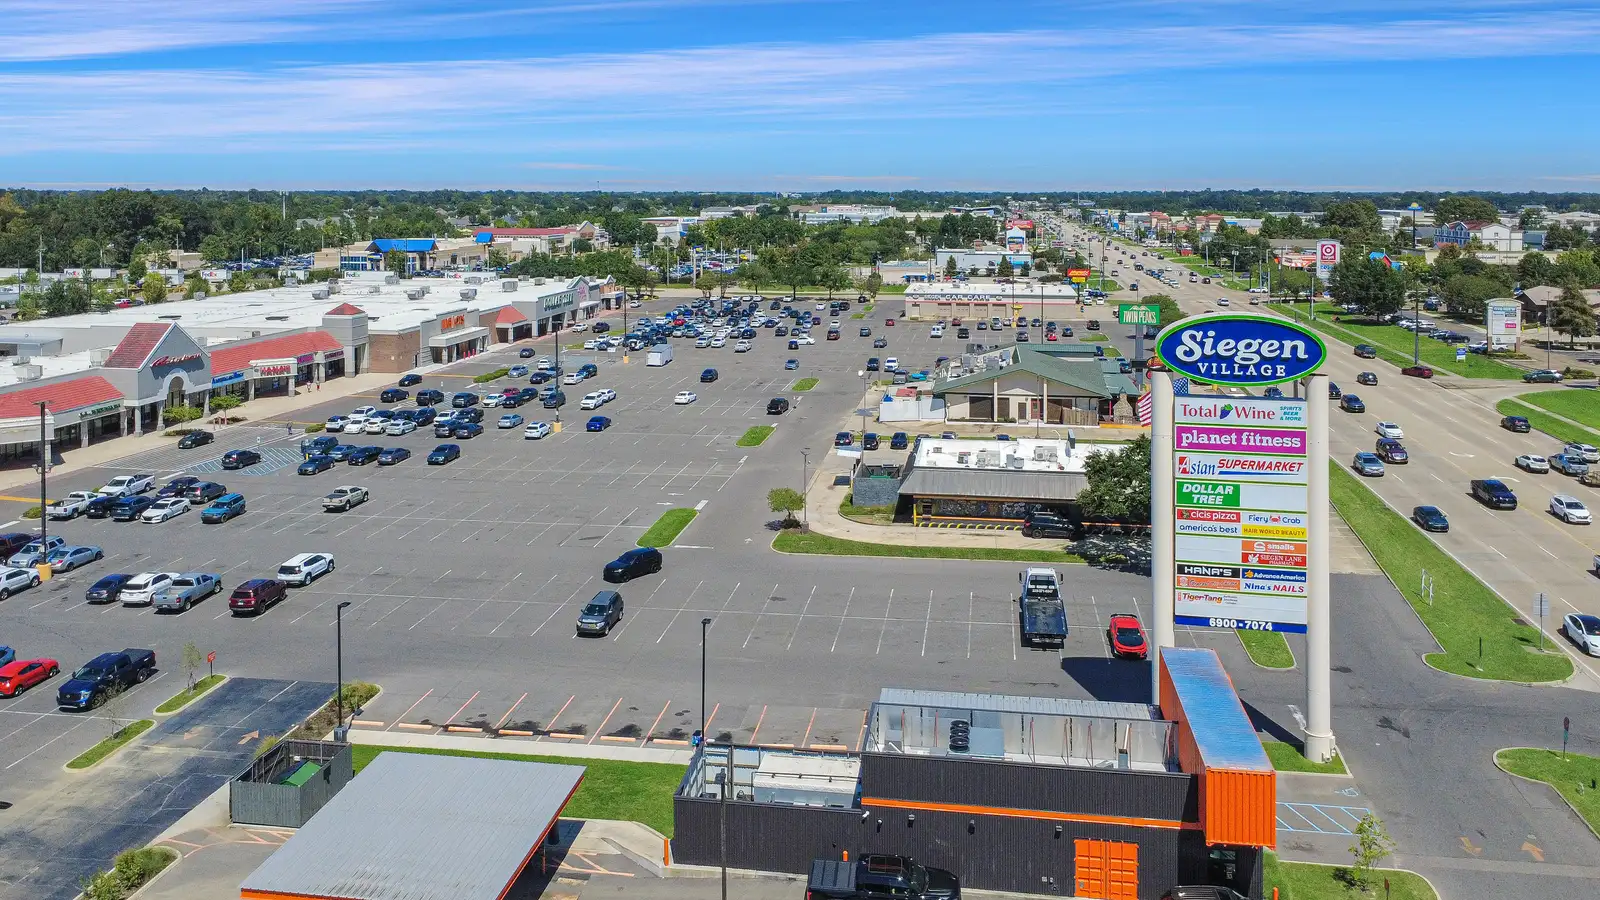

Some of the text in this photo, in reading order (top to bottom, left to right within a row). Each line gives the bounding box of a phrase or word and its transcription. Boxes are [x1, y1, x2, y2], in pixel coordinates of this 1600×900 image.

[1123, 311, 1156, 324] TWIN PEAKS
[1175, 329, 1309, 364] Siegen
[1197, 362, 1286, 377] VILLAGE
[1180, 404, 1275, 420] Total Wine
[1181, 430, 1301, 447] planet fitness
[1178, 456, 1304, 476] Asian SUPERMARKET
[1182, 483, 1234, 495] DOLLAR
[1192, 494, 1224, 505] TREE
[1190, 511, 1237, 520] cicis pizza
[1248, 514, 1301, 524] Fiery Crab
[1179, 524, 1238, 533] america's best
[1267, 543, 1295, 551] smalls
[1184, 566, 1232, 576] HANA'S
[1244, 582, 1271, 590] Nina's
[1272, 584, 1304, 593] NAILS
